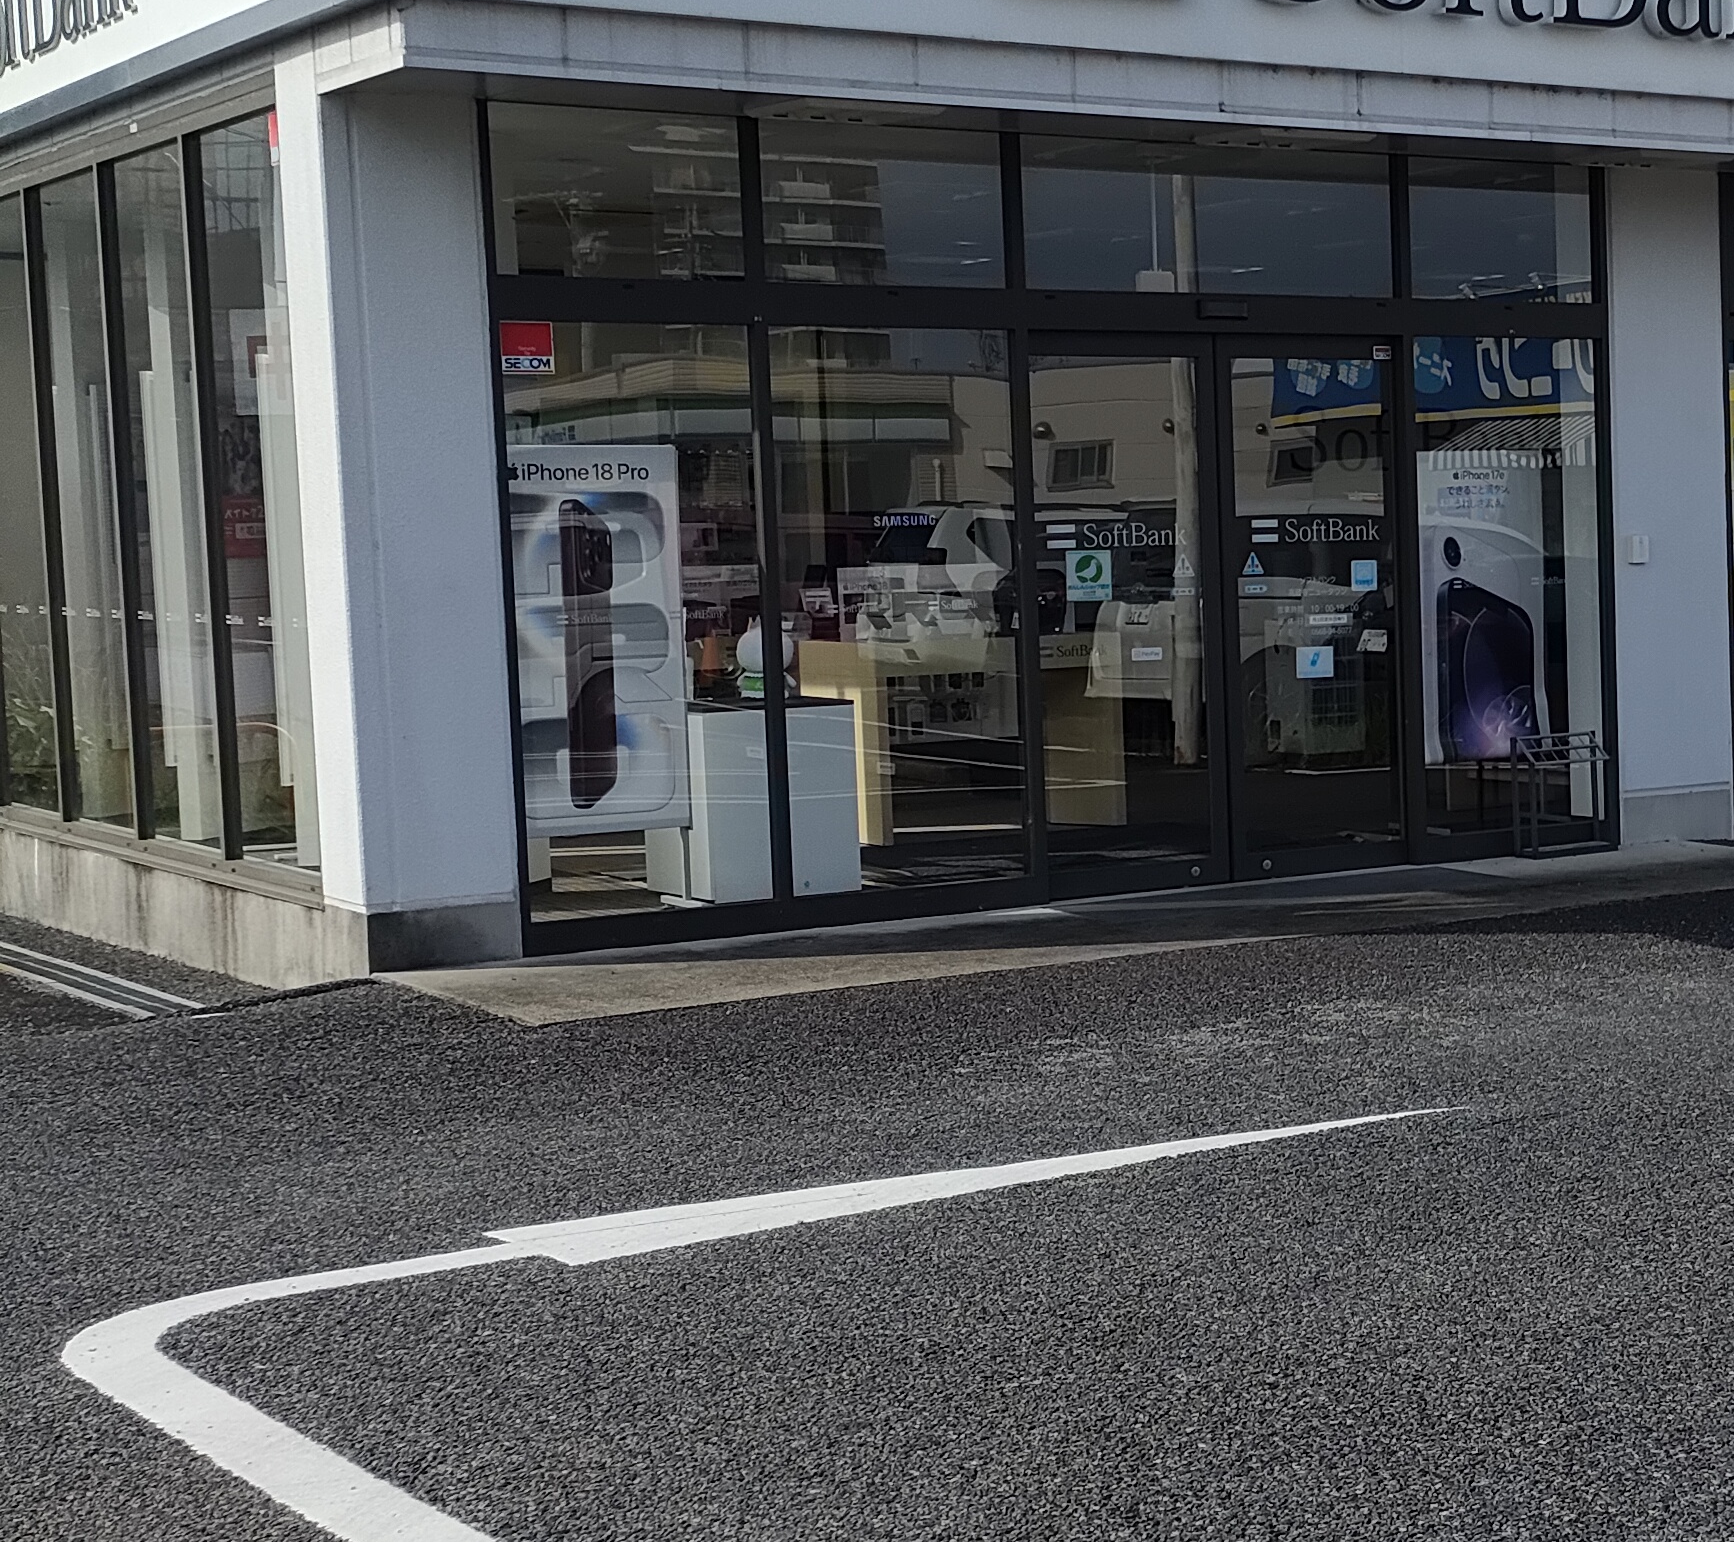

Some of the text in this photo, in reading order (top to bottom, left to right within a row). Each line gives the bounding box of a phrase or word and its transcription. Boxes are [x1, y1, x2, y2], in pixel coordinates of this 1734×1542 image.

[504, 357, 551, 369] SECOM
[521, 463, 649, 480] iPhone 18 Pro
[1461, 471, 1489, 480] iPhone
[873, 514, 936, 527] SAMSUNG
[1083, 523, 1187, 547] SoftBank
[1285, 518, 1380, 543] SoftBank
